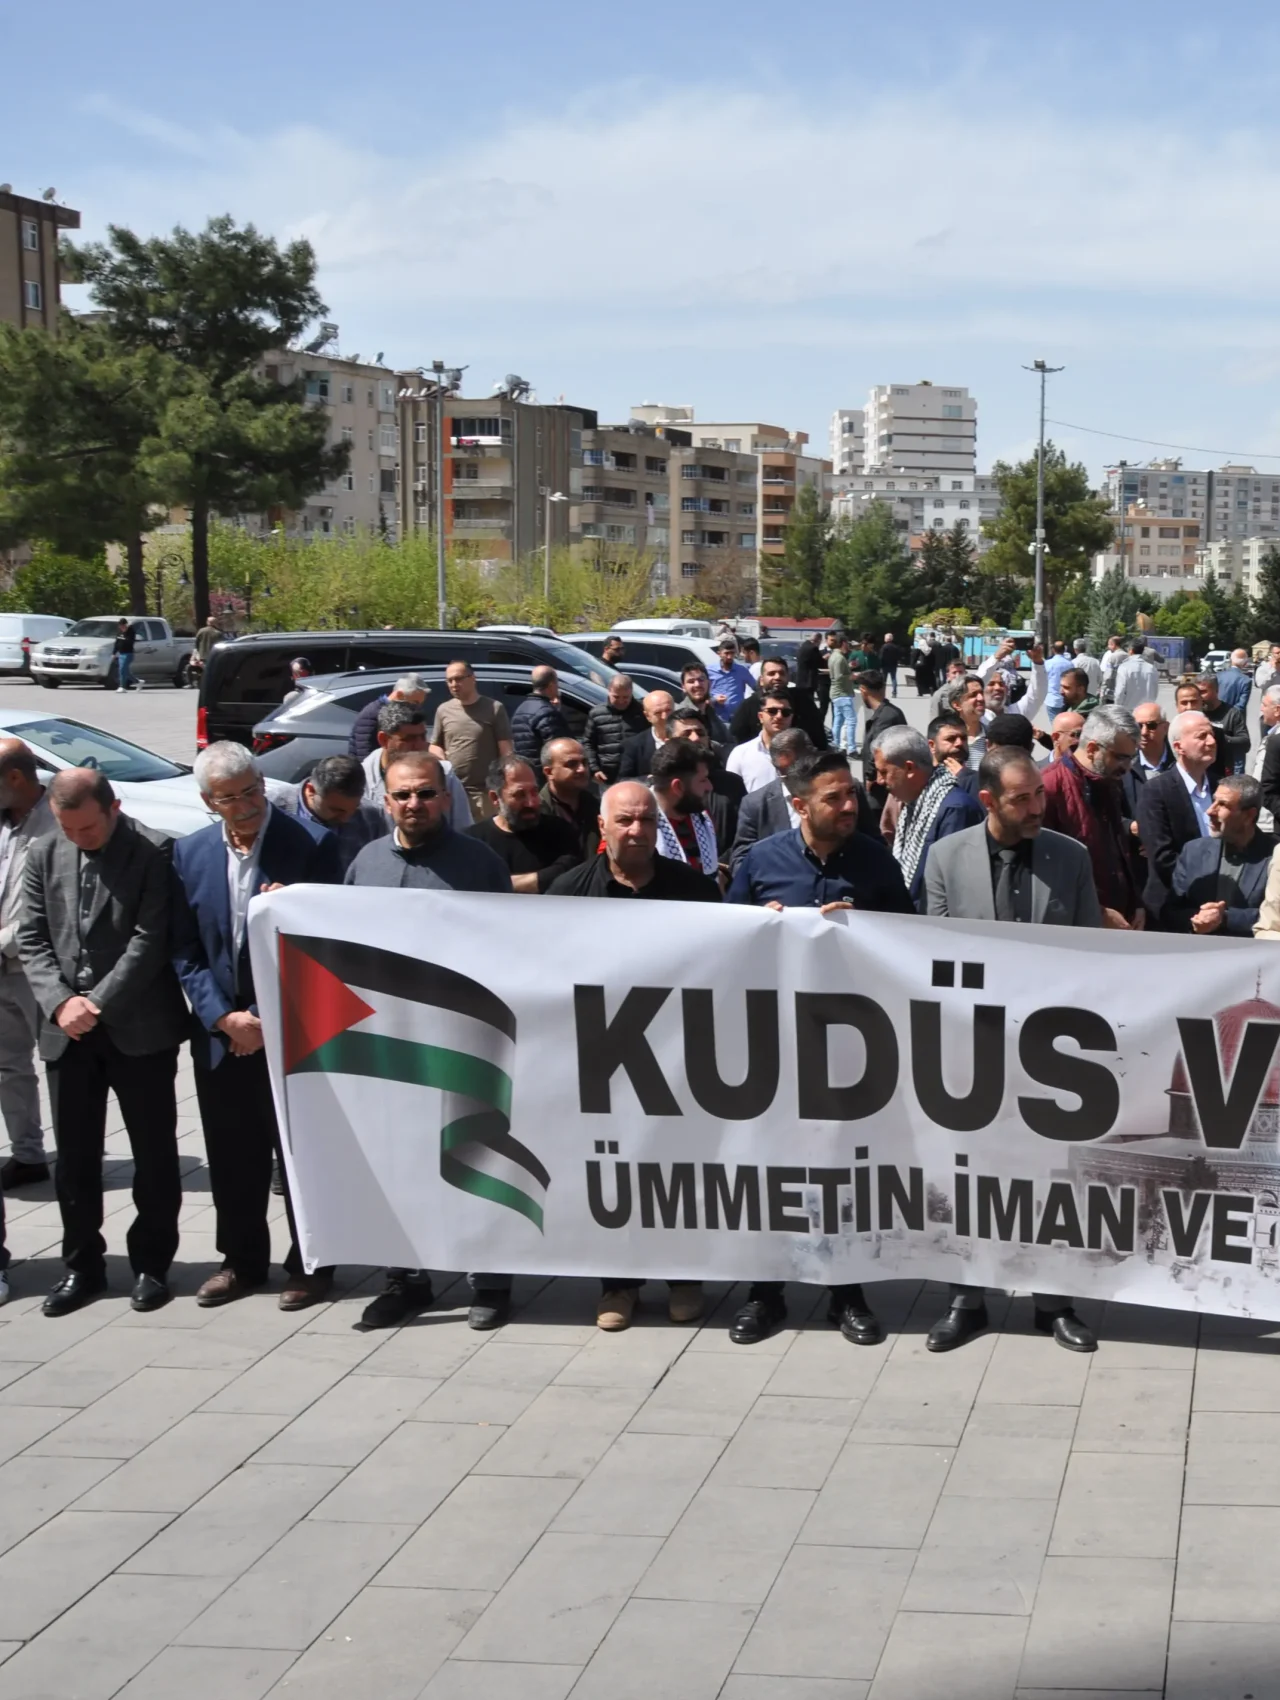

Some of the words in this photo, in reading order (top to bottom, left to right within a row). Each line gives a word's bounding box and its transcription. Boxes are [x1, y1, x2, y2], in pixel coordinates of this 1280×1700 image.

[574, 960, 1120, 1141] KUDÜS
[586, 1140, 925, 1233] ÜMMETİN
[955, 1154, 1135, 1253] İMAN
[1162, 1190, 1254, 1265] VE
